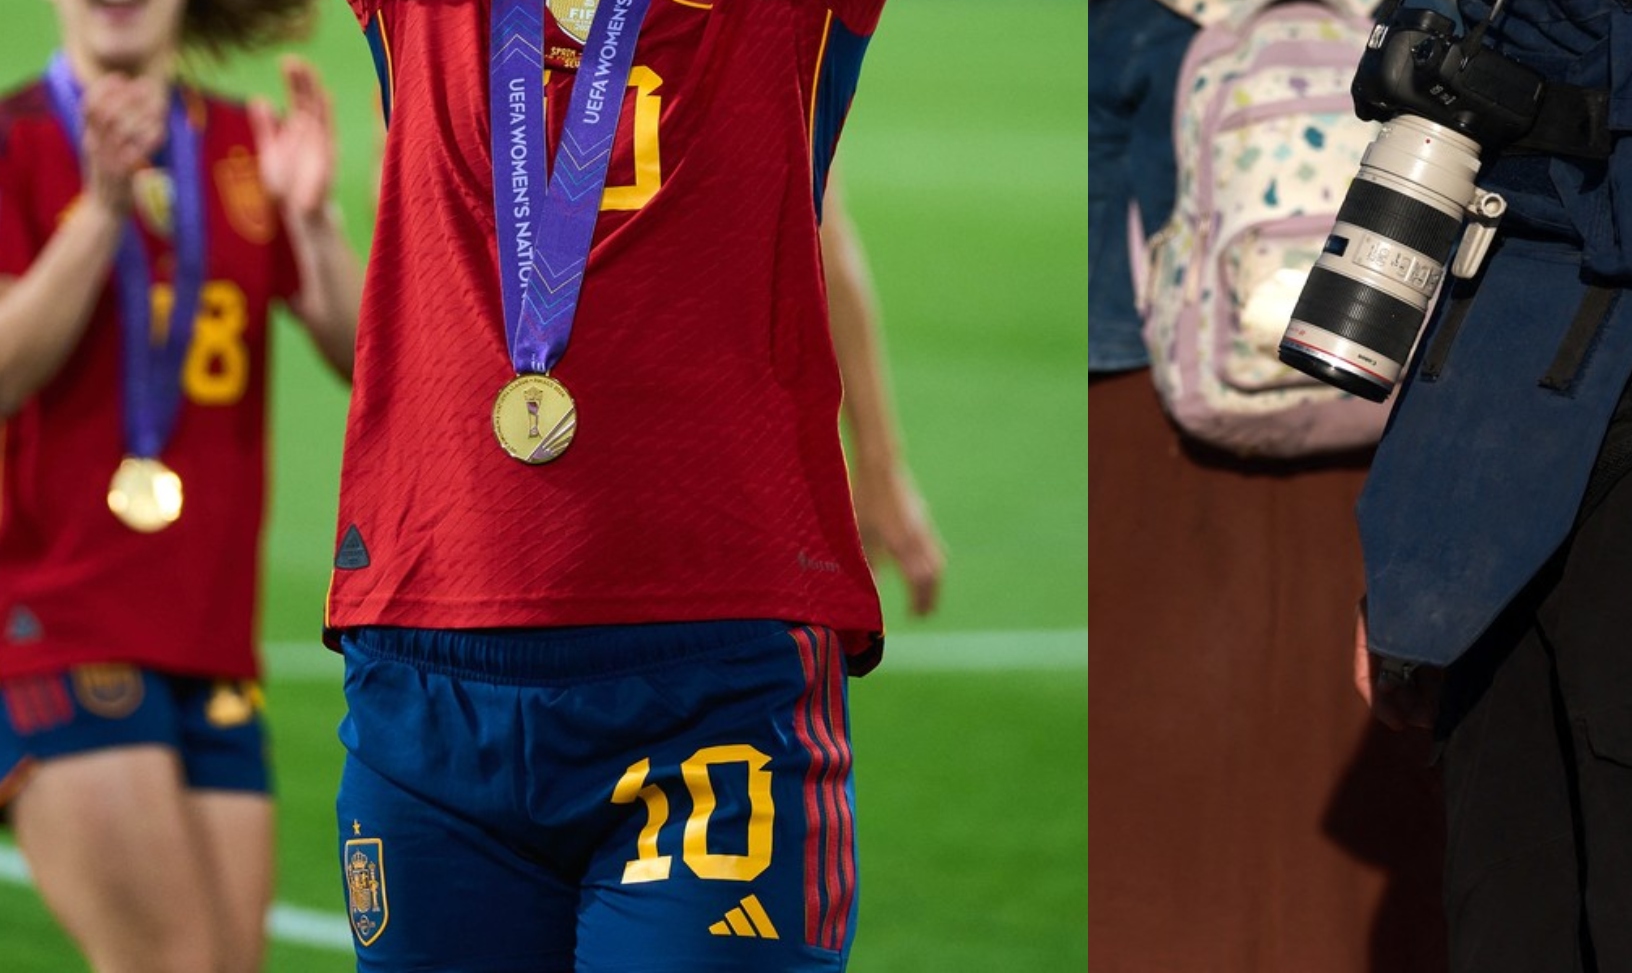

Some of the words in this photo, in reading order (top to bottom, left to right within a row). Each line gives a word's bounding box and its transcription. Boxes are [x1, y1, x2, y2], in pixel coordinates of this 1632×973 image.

[569, 8, 595, 20] FIF
[509, 78, 526, 125] UEFA
[582, 78, 609, 125] UEFA
[510, 125, 531, 218] WOMEN'S
[514, 221, 534, 298] NATIO
[610, 744, 776, 885] 10
